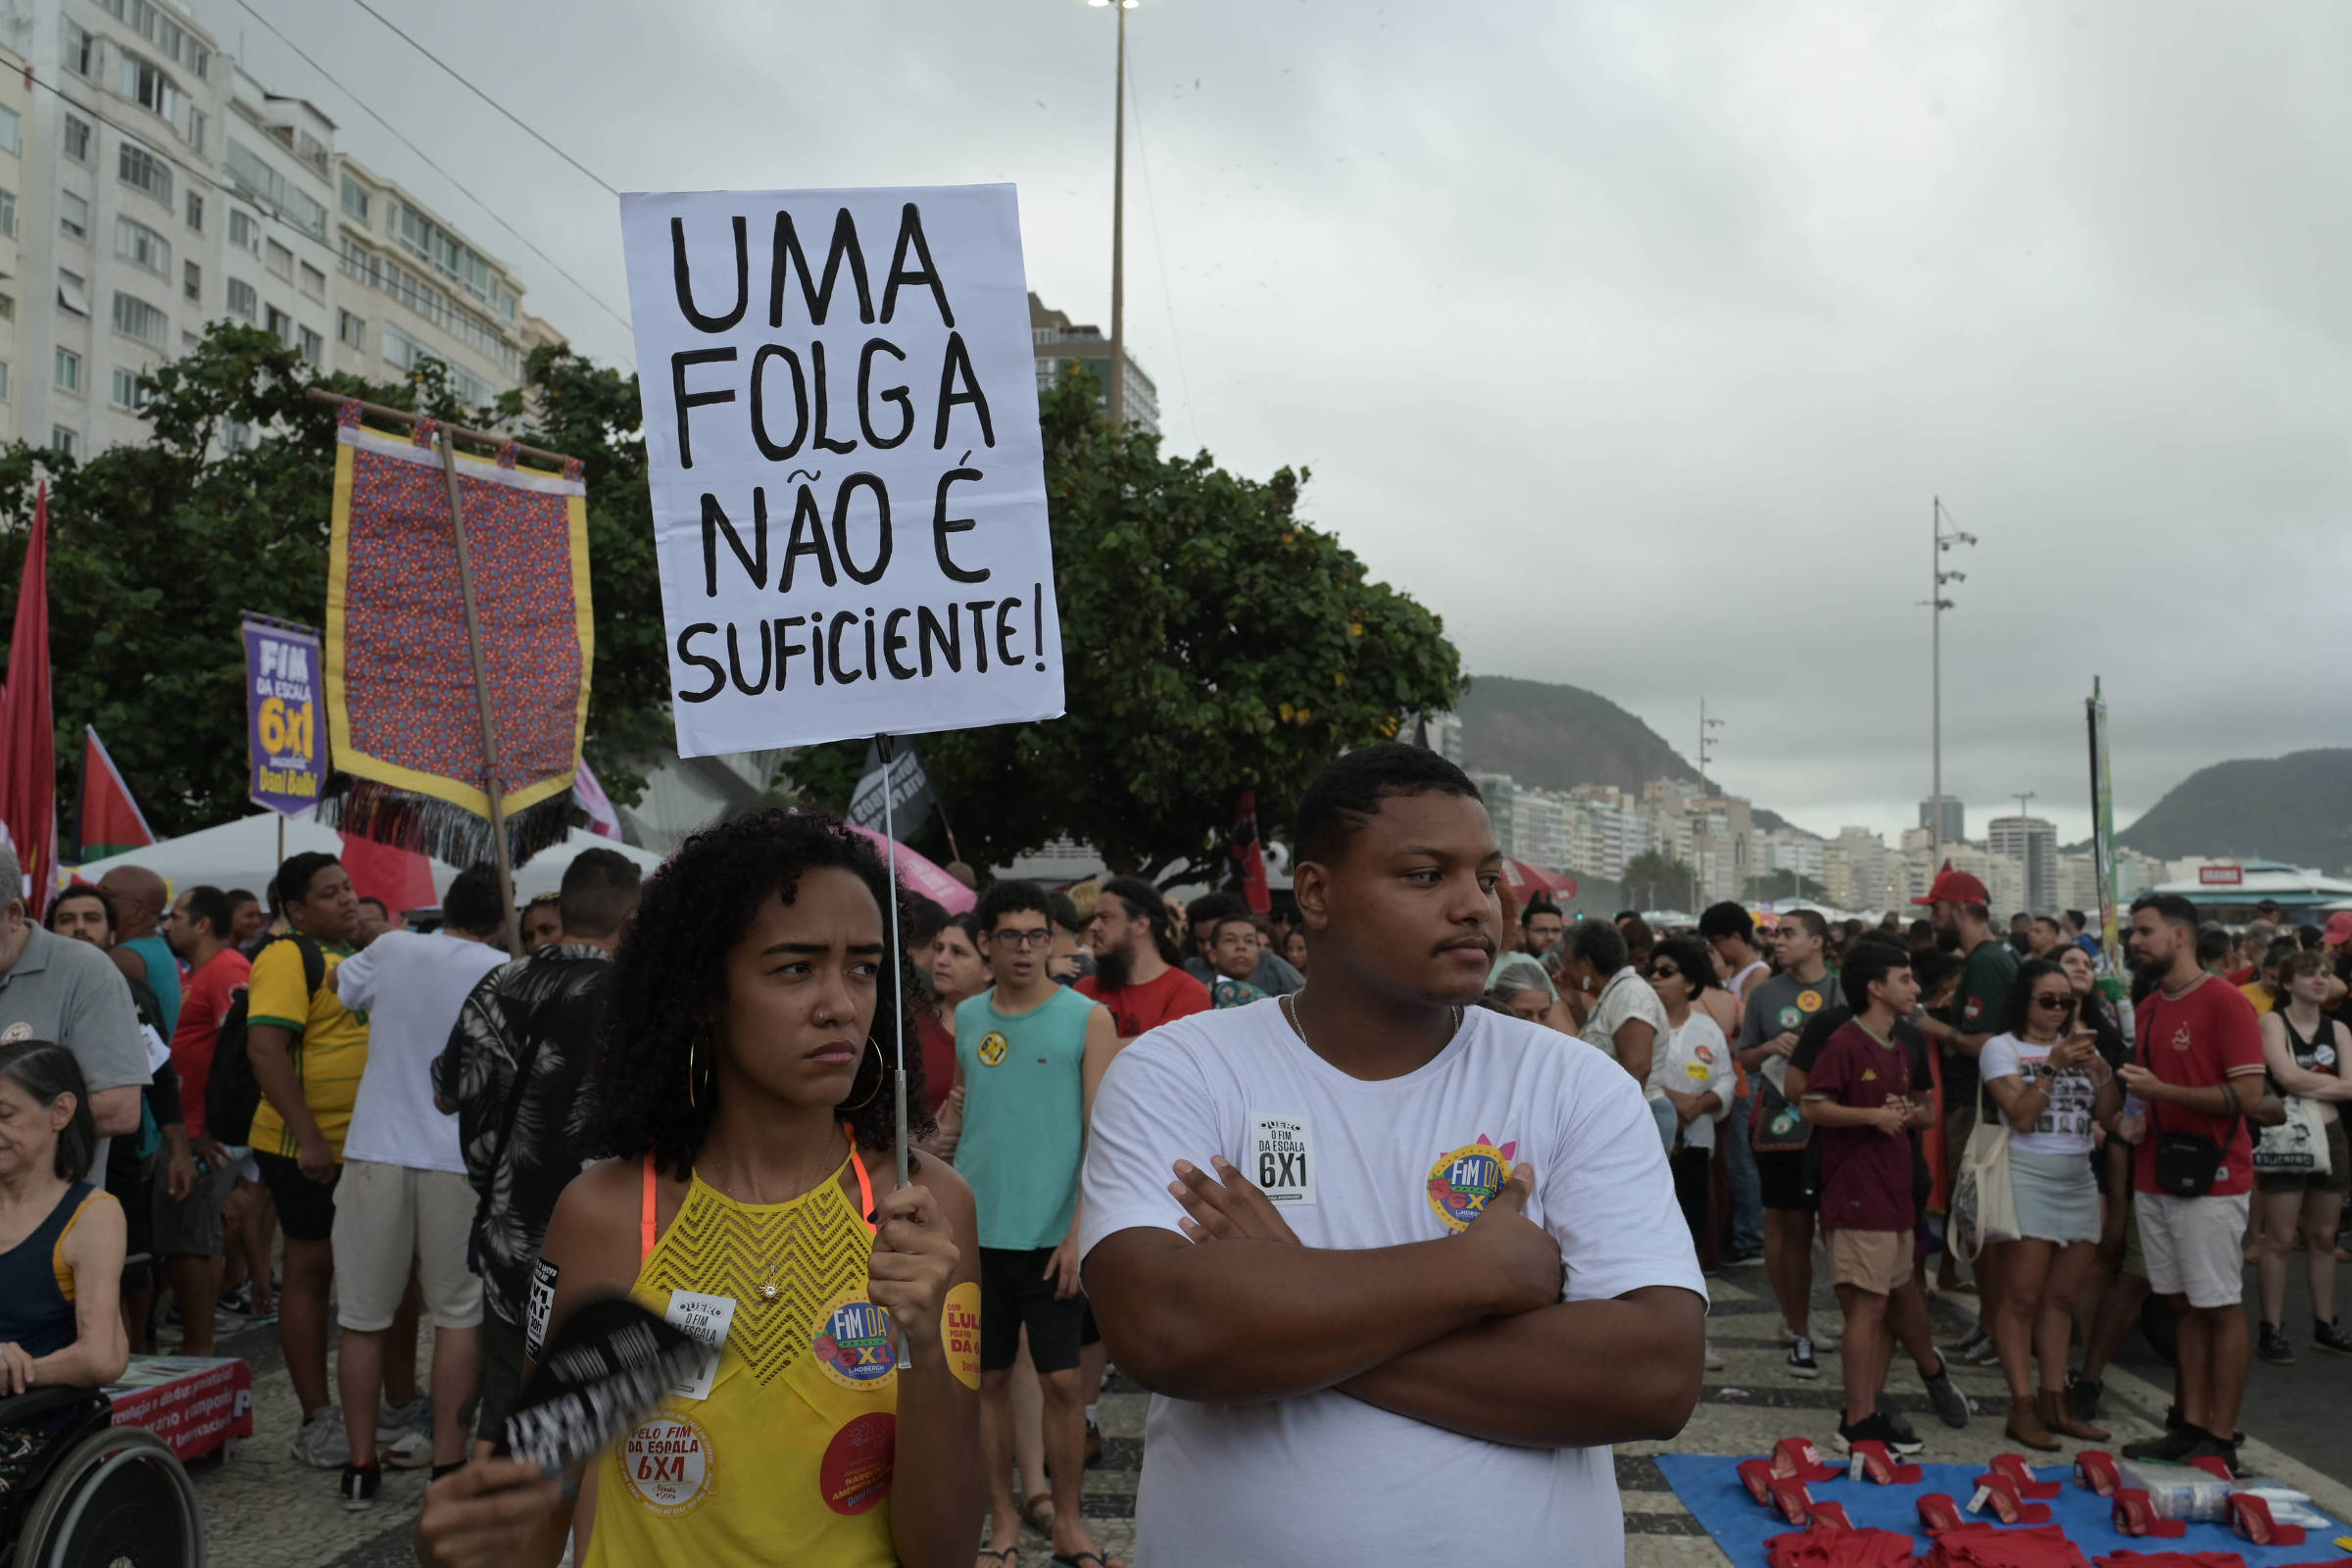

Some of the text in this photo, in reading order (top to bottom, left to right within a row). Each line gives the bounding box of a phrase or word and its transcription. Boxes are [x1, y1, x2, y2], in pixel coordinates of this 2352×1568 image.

[671, 203, 955, 333] UMA
[671, 331, 996, 468] FOLGA
[701, 450, 990, 597] NÃO É
[260, 640, 309, 683] FIM
[257, 676, 313, 702] DA ESCALA
[1259, 1141, 1304, 1152] DA ESCALA
[1271, 1130, 1292, 1141] O FIM
[1259, 1152, 1306, 1188] 6X1
[1484, 1161, 1499, 1192] DA
[693, 1314, 709, 1327] FIM
[865, 1307, 887, 1338] DA
[951, 1339, 972, 1353] DA
[631, 1426, 692, 1439] PELO FIM
[628, 1441, 643, 1452] DA
[637, 1456, 685, 1482] 6X1
